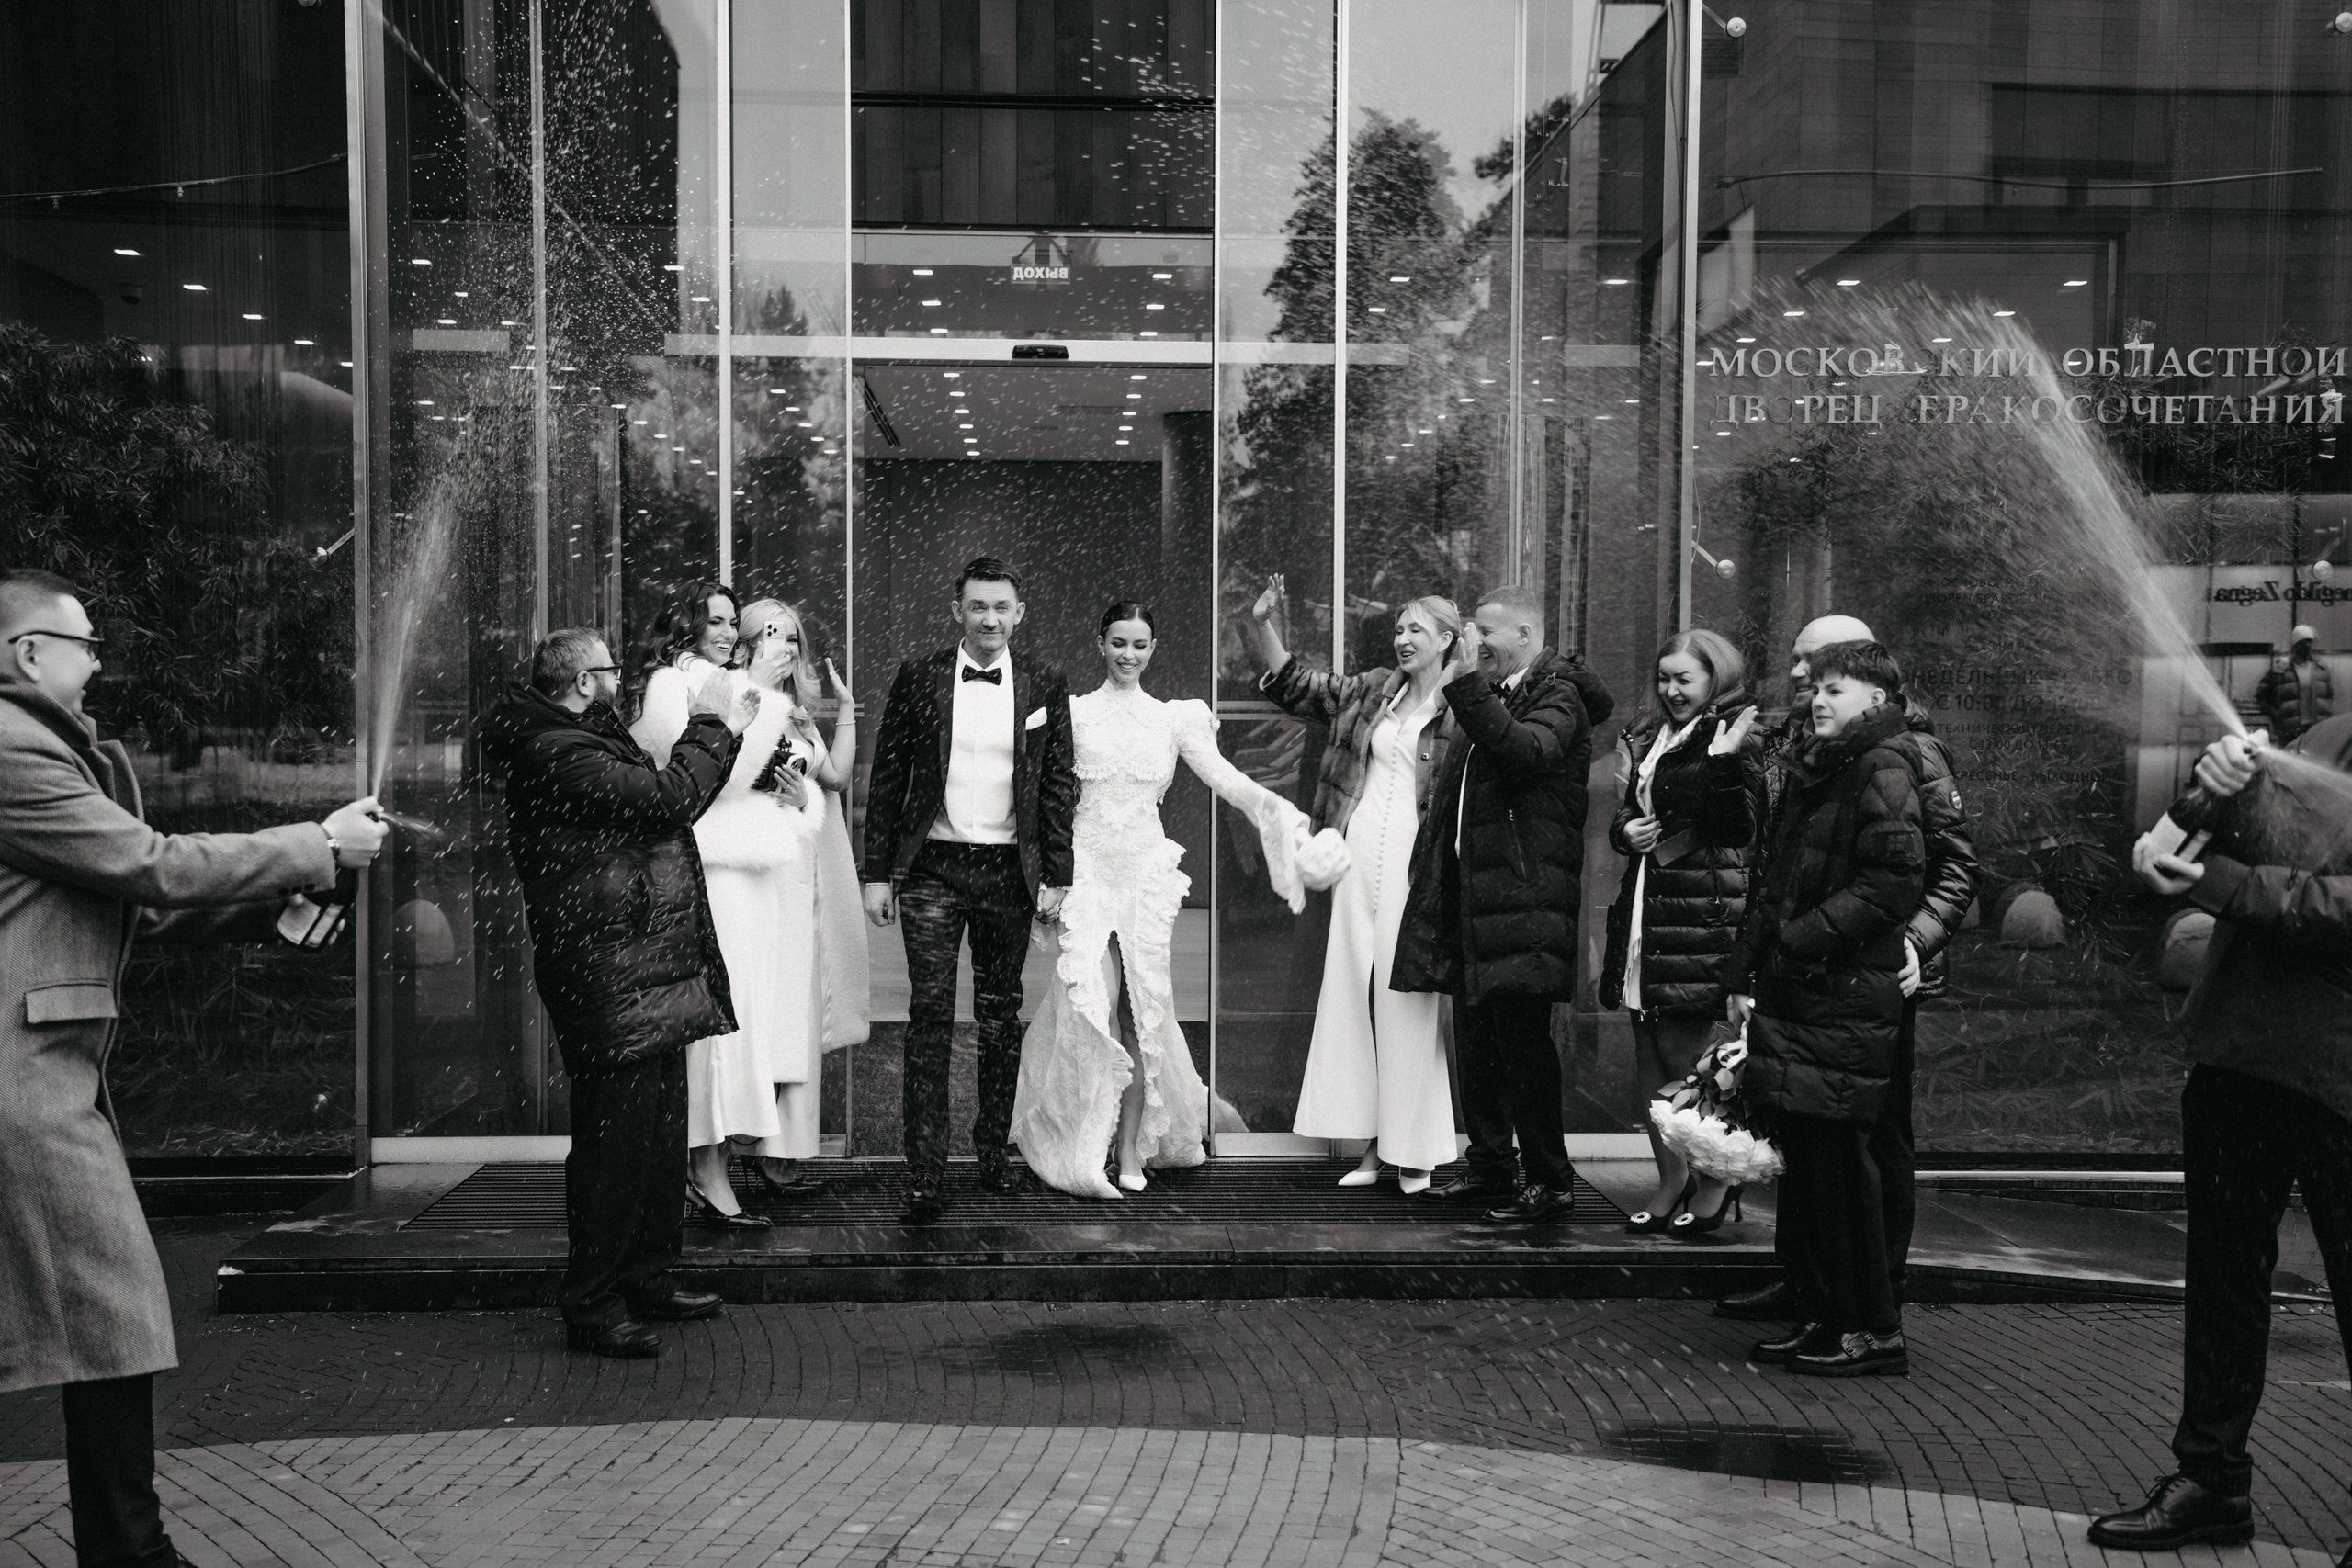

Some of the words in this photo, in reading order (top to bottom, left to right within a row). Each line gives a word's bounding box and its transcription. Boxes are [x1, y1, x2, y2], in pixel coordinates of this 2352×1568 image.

[1709, 395, 1882, 430] ДВОРЕЦ
[1898, 669, 2041, 687] ОНЕДЕЛЬНИК
[1954, 771, 2018, 782] КРЕСЕНЬЕ
